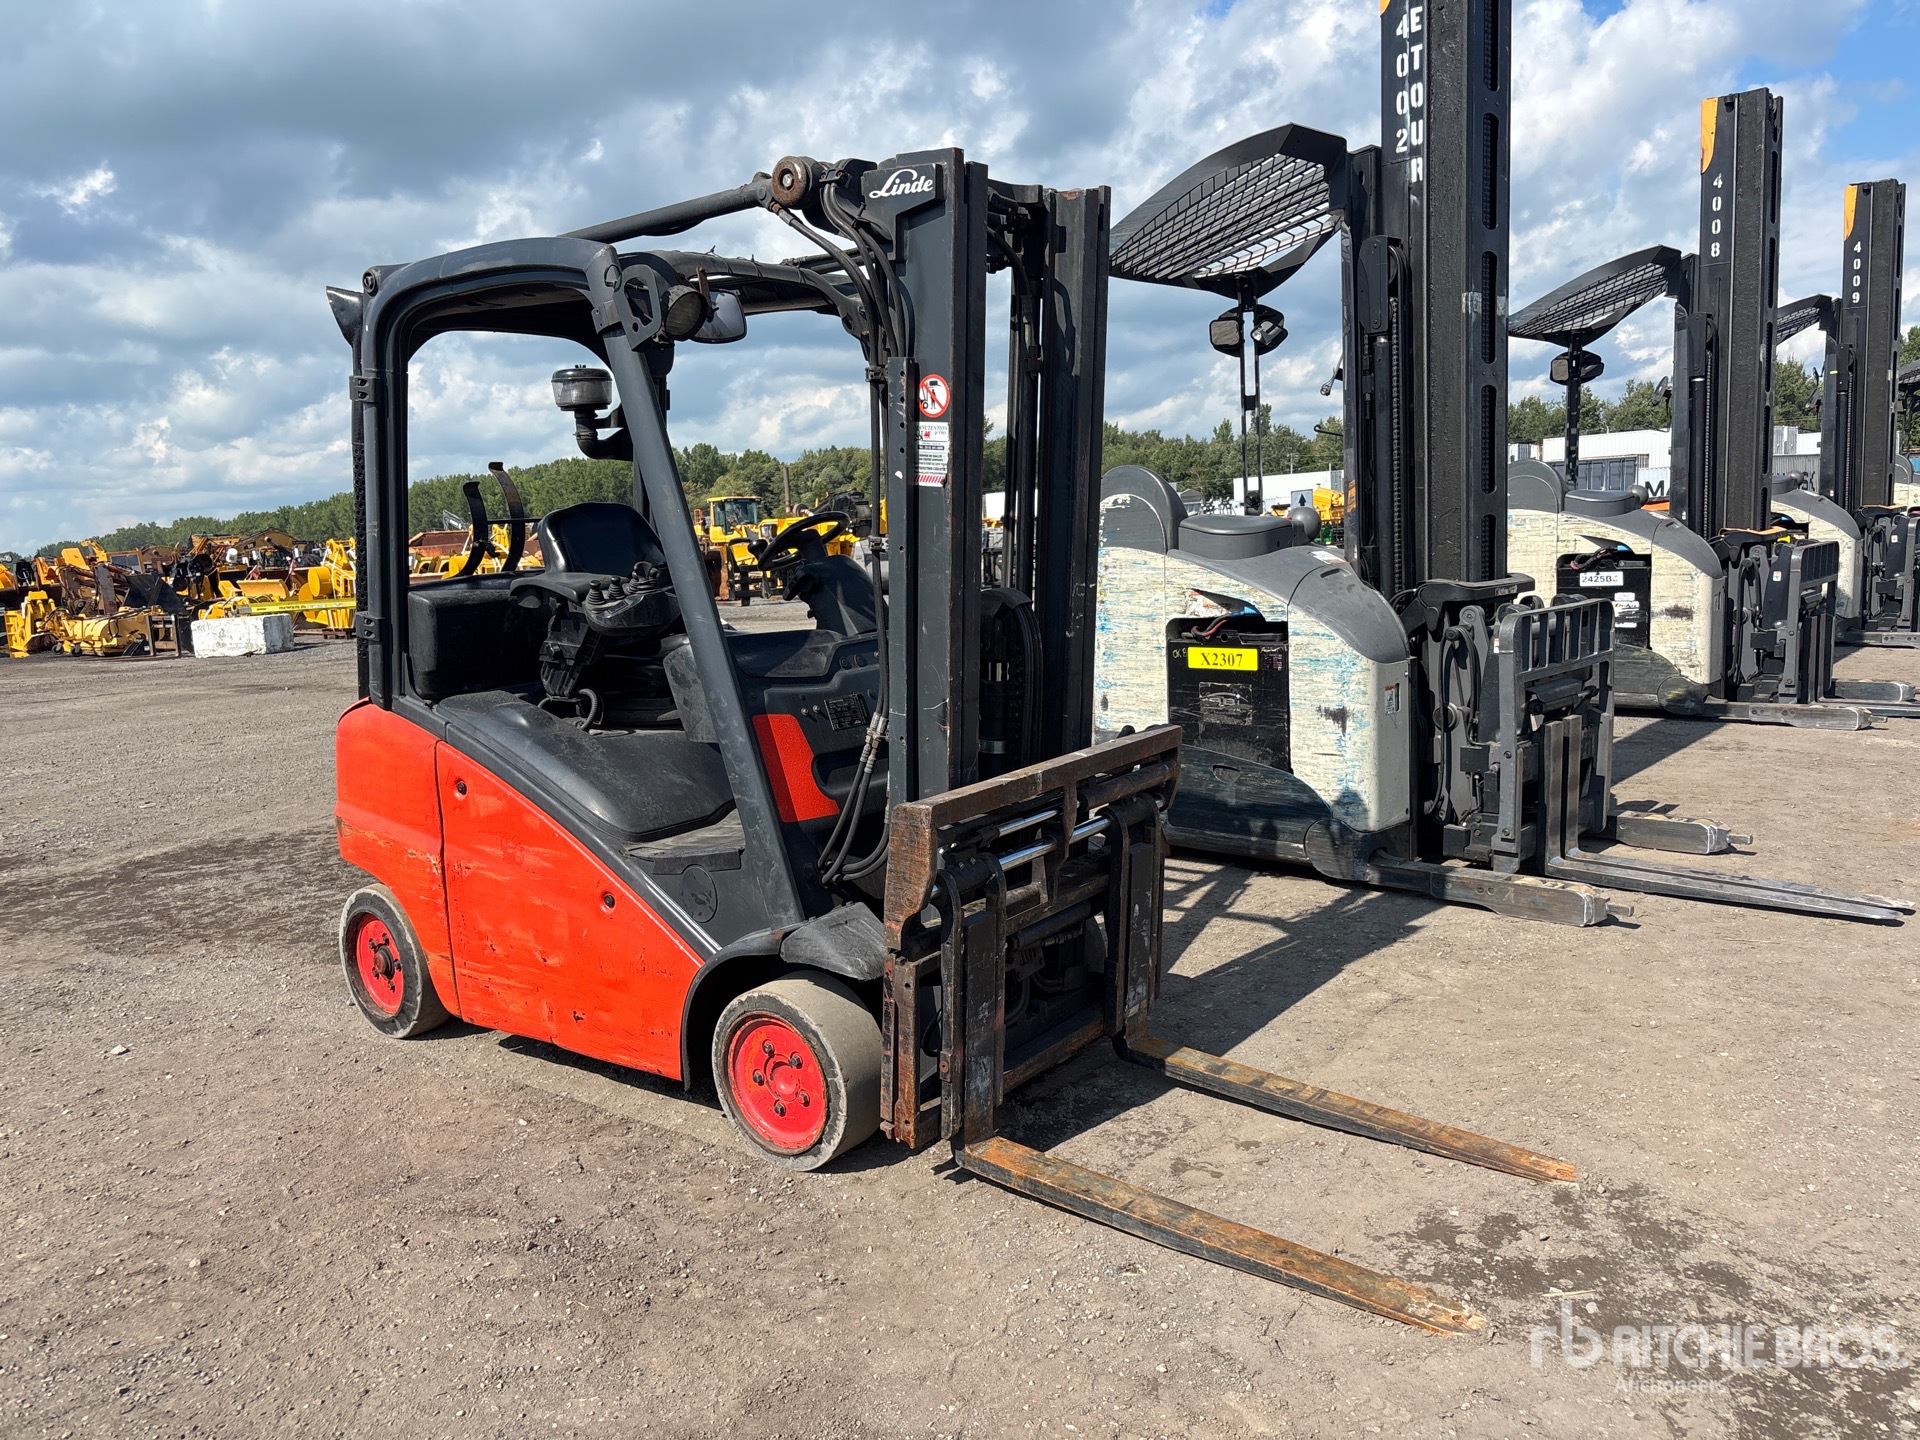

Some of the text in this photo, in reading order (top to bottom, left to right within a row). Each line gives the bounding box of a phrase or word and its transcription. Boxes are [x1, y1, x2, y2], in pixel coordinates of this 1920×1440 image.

[1396, 14, 1409, 154] 4002
[869, 168, 933, 198] Linde
[1710, 173, 1722, 257] 4008
[1852, 241, 1862, 304] 4009
[1201, 652, 1243, 667] X2307
